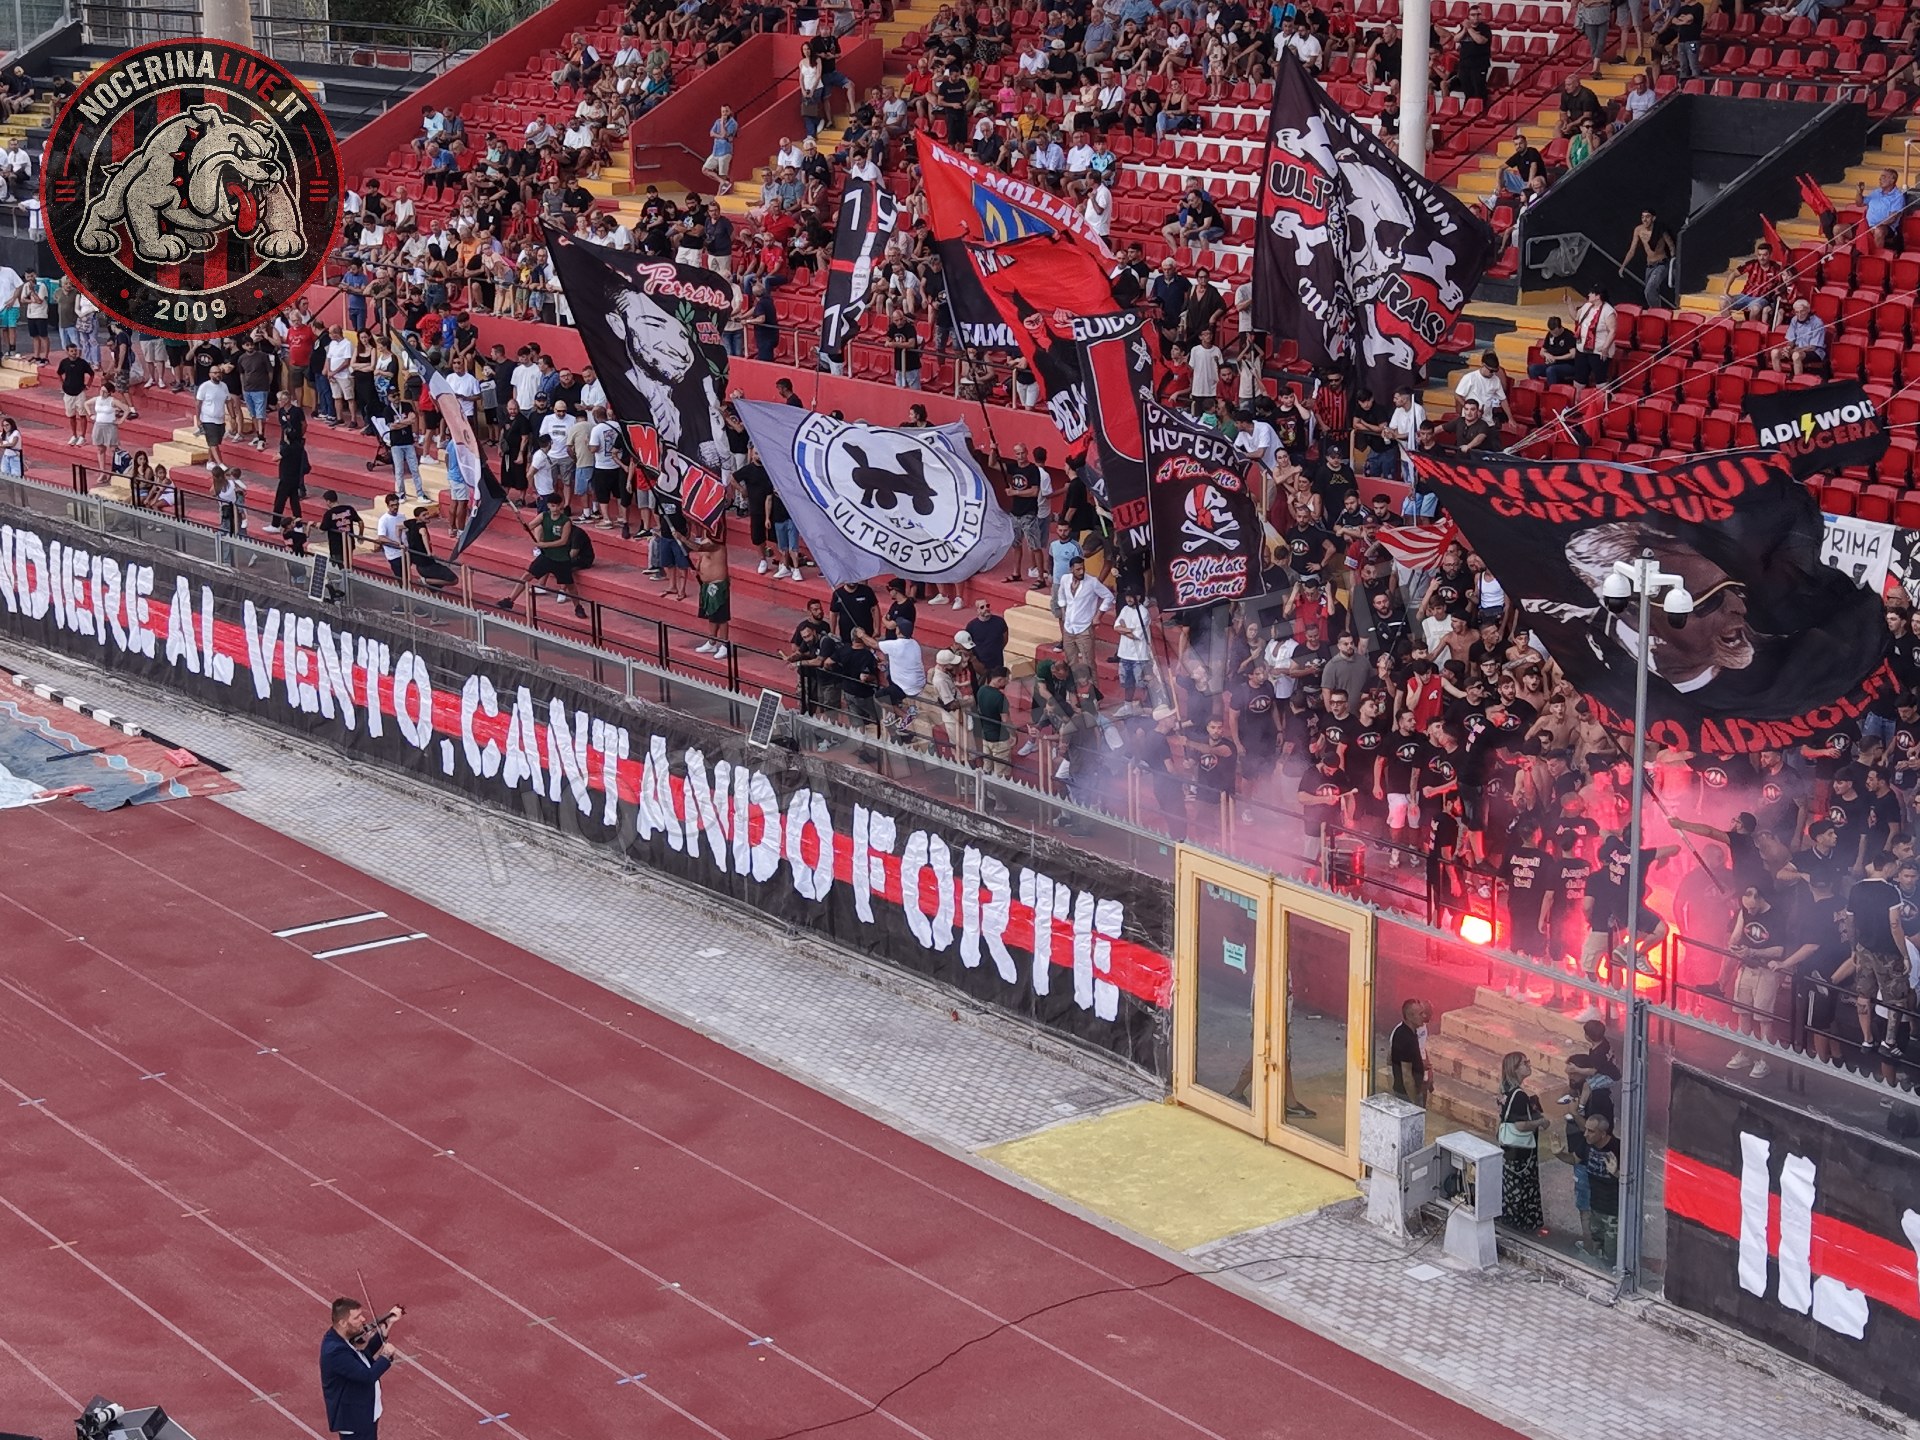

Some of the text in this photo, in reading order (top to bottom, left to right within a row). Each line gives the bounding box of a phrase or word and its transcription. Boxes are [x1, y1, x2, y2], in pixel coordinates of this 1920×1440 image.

[1073, 313, 1136, 341] GUIDO
[1779, 420, 1879, 458] NOCERA
[834, 500, 982, 566] ULTRAS PORTICI
[1171, 554, 1247, 583] Diffidati
[1177, 578, 1246, 603] Presenti
[166, 575, 234, 686] AL
[852, 802, 1124, 1022] FORTE
[1738, 1131, 1869, 1340] IL
